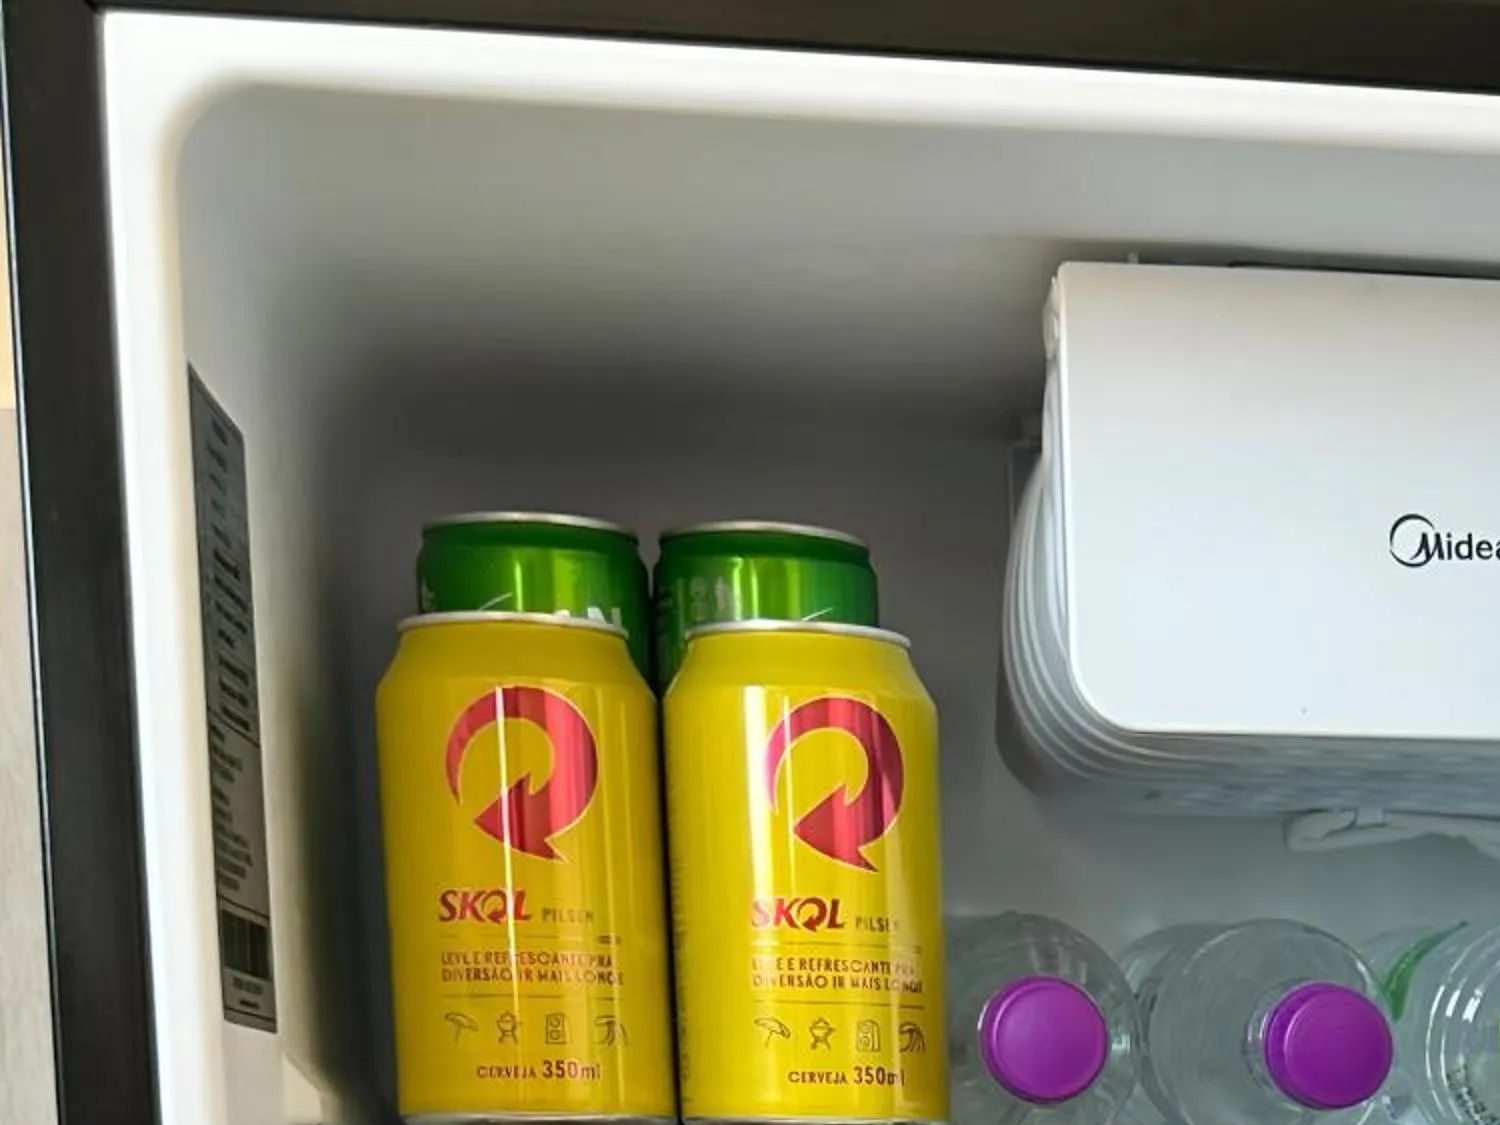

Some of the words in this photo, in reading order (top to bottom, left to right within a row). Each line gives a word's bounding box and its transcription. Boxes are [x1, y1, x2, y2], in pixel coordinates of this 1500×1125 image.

[439, 888, 532, 924] SKOL
[751, 896, 847, 932] SKOL
[476, 1064, 538, 1080] CERVEJA
[787, 1070, 849, 1086] CERVEJA
